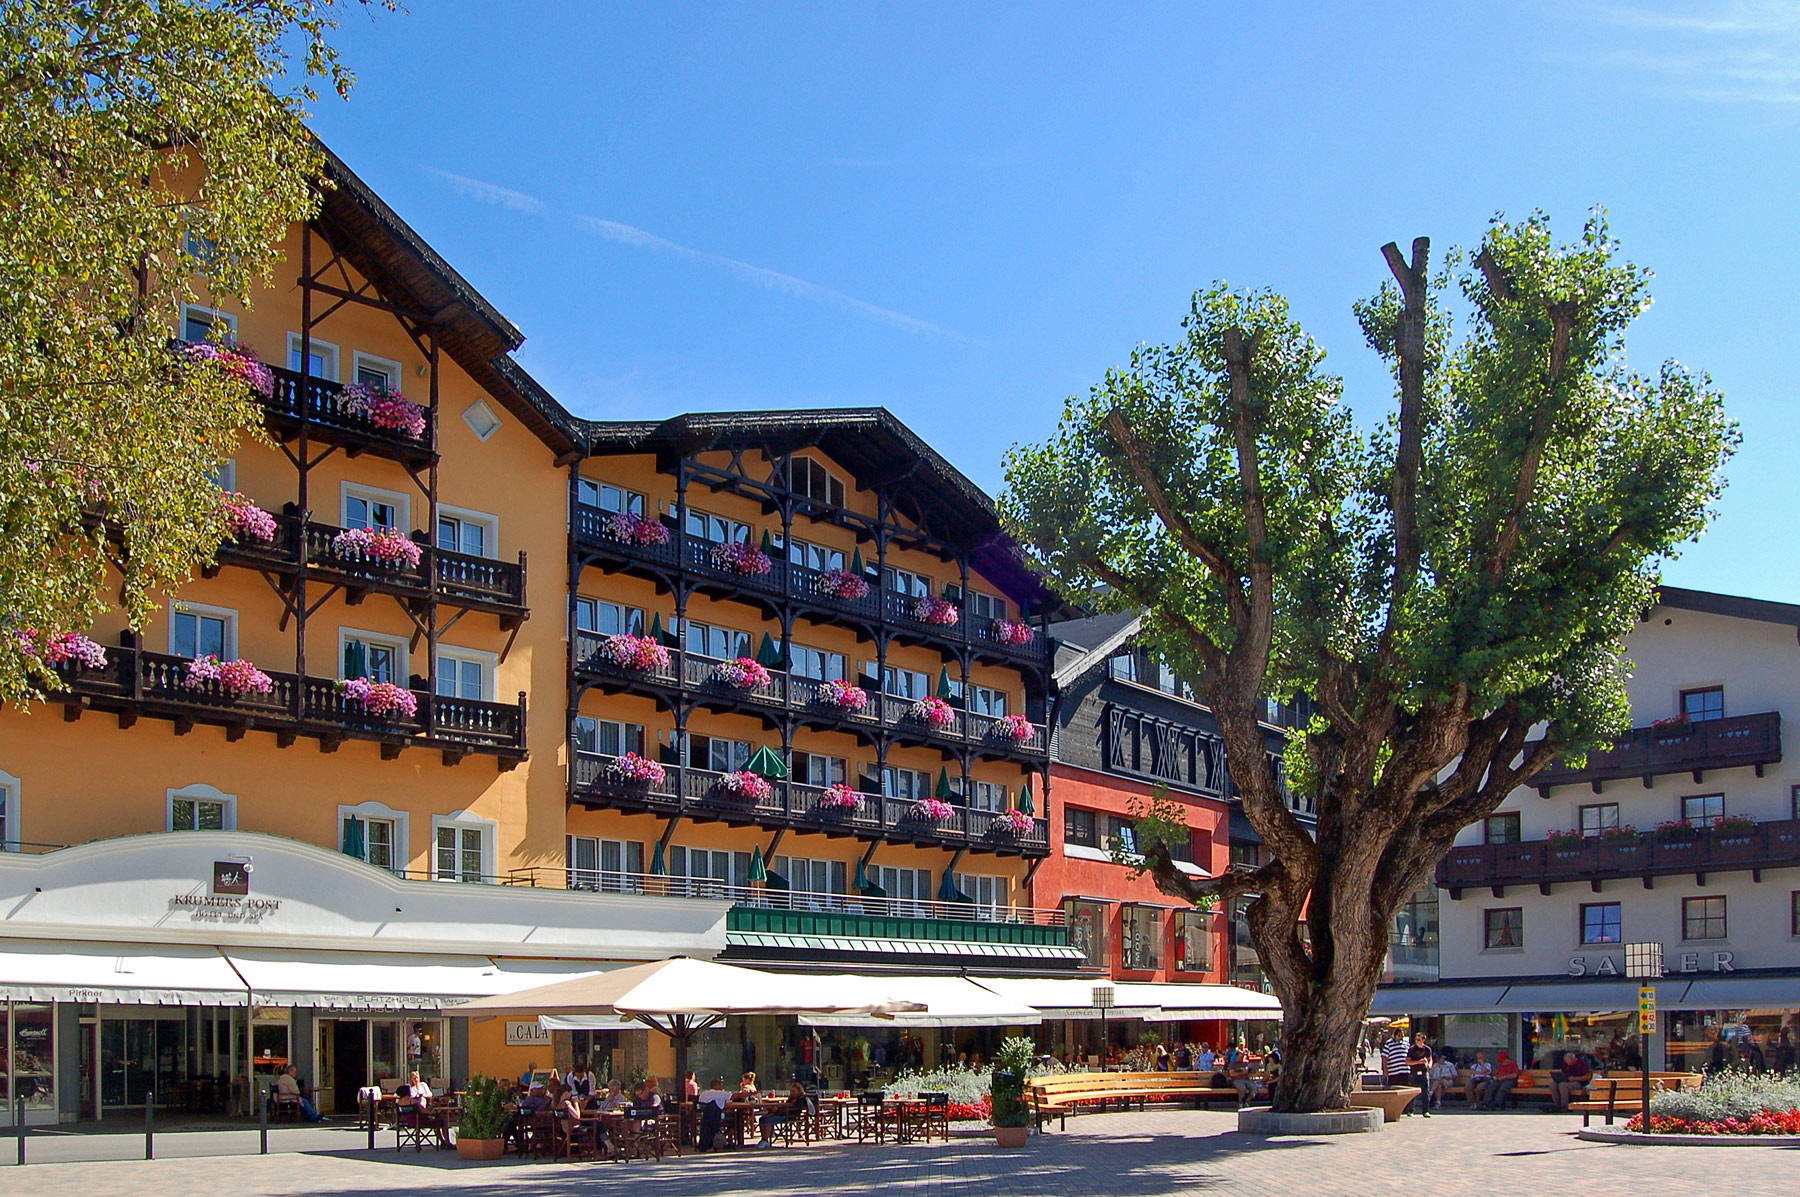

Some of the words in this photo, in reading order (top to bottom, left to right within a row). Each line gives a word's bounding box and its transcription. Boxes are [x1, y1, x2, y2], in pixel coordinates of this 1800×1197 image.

[175, 894, 241, 907] KRUMERS
[248, 899, 282, 910] POST
[196, 910, 222, 918] HOTEL
[1568, 951, 1735, 977] SAER
[516, 1024, 548, 1039] CALA
